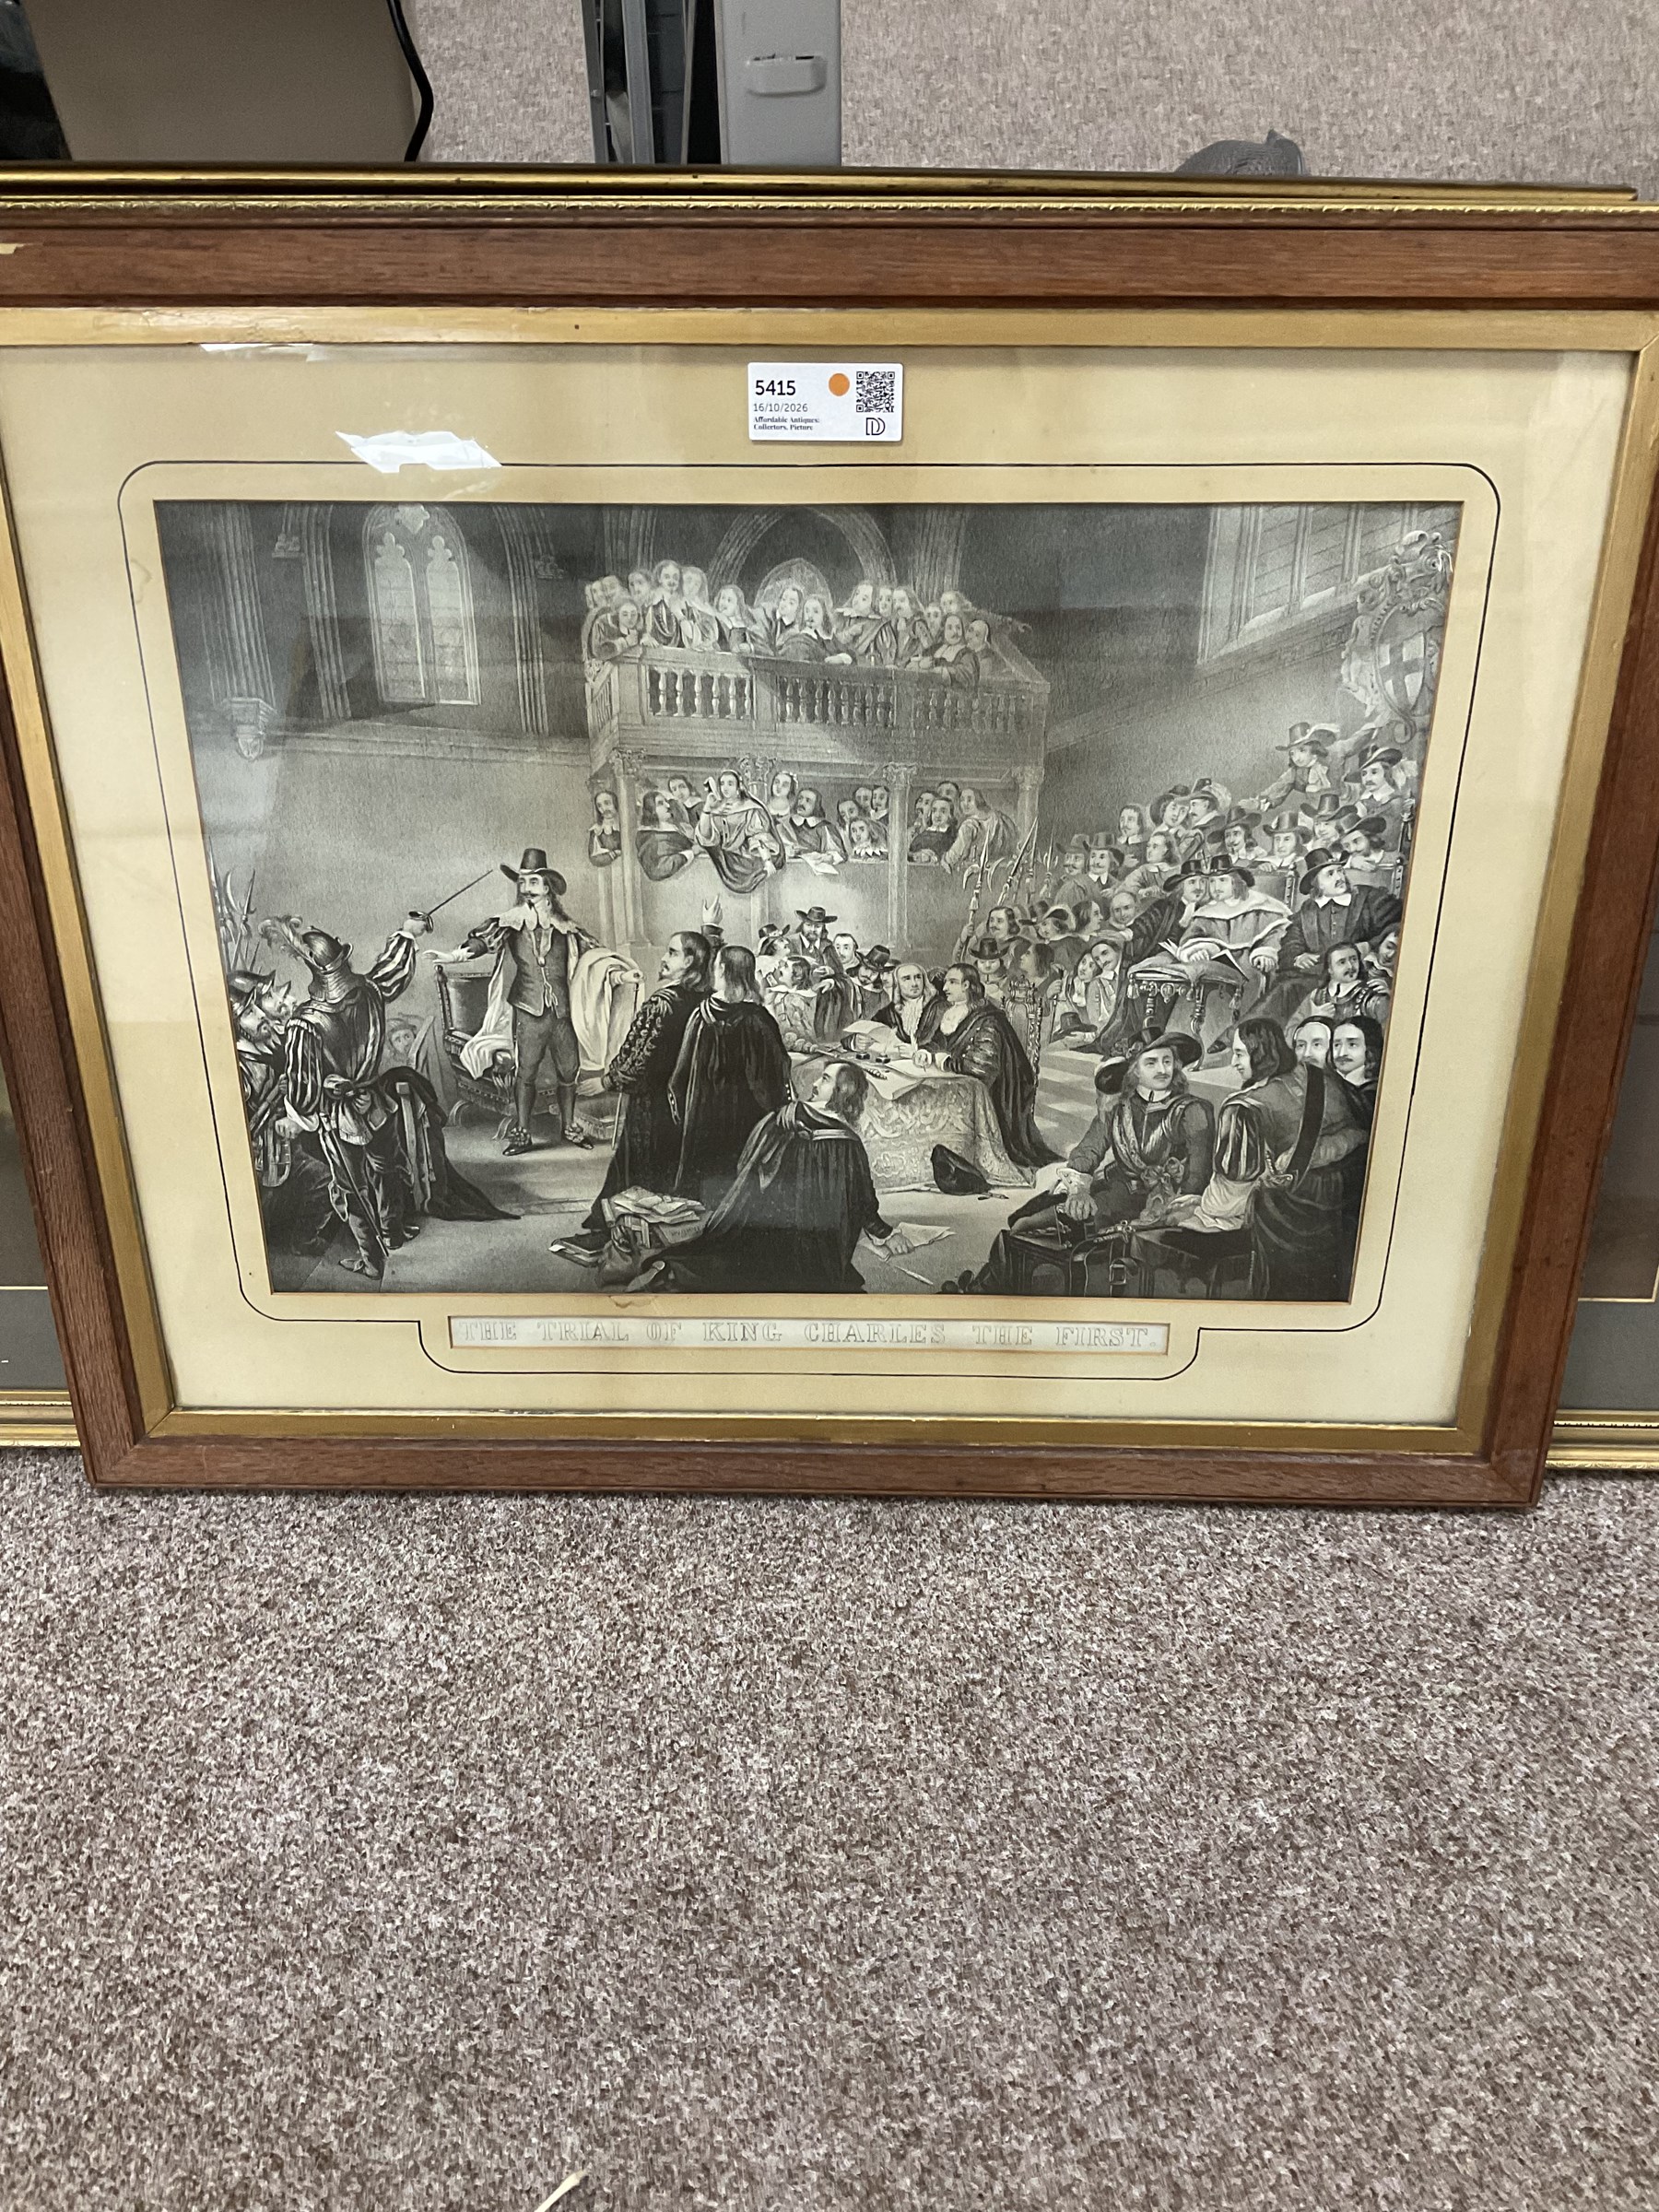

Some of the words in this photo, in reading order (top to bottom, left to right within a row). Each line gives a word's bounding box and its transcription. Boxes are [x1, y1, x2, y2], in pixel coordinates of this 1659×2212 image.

[755, 380, 796, 395] 5415
[753, 403, 808, 412] 16/10/2026
[459, 1322, 516, 1341] THE
[537, 1322, 629, 1342] TRIAL
[646, 1322, 682, 1342] OF
[703, 1322, 782, 1342] KING
[804, 1322, 946, 1344] CHARLES
[972, 1324, 1033, 1346] THE
[1055, 1325, 1156, 1347] FIRST.
